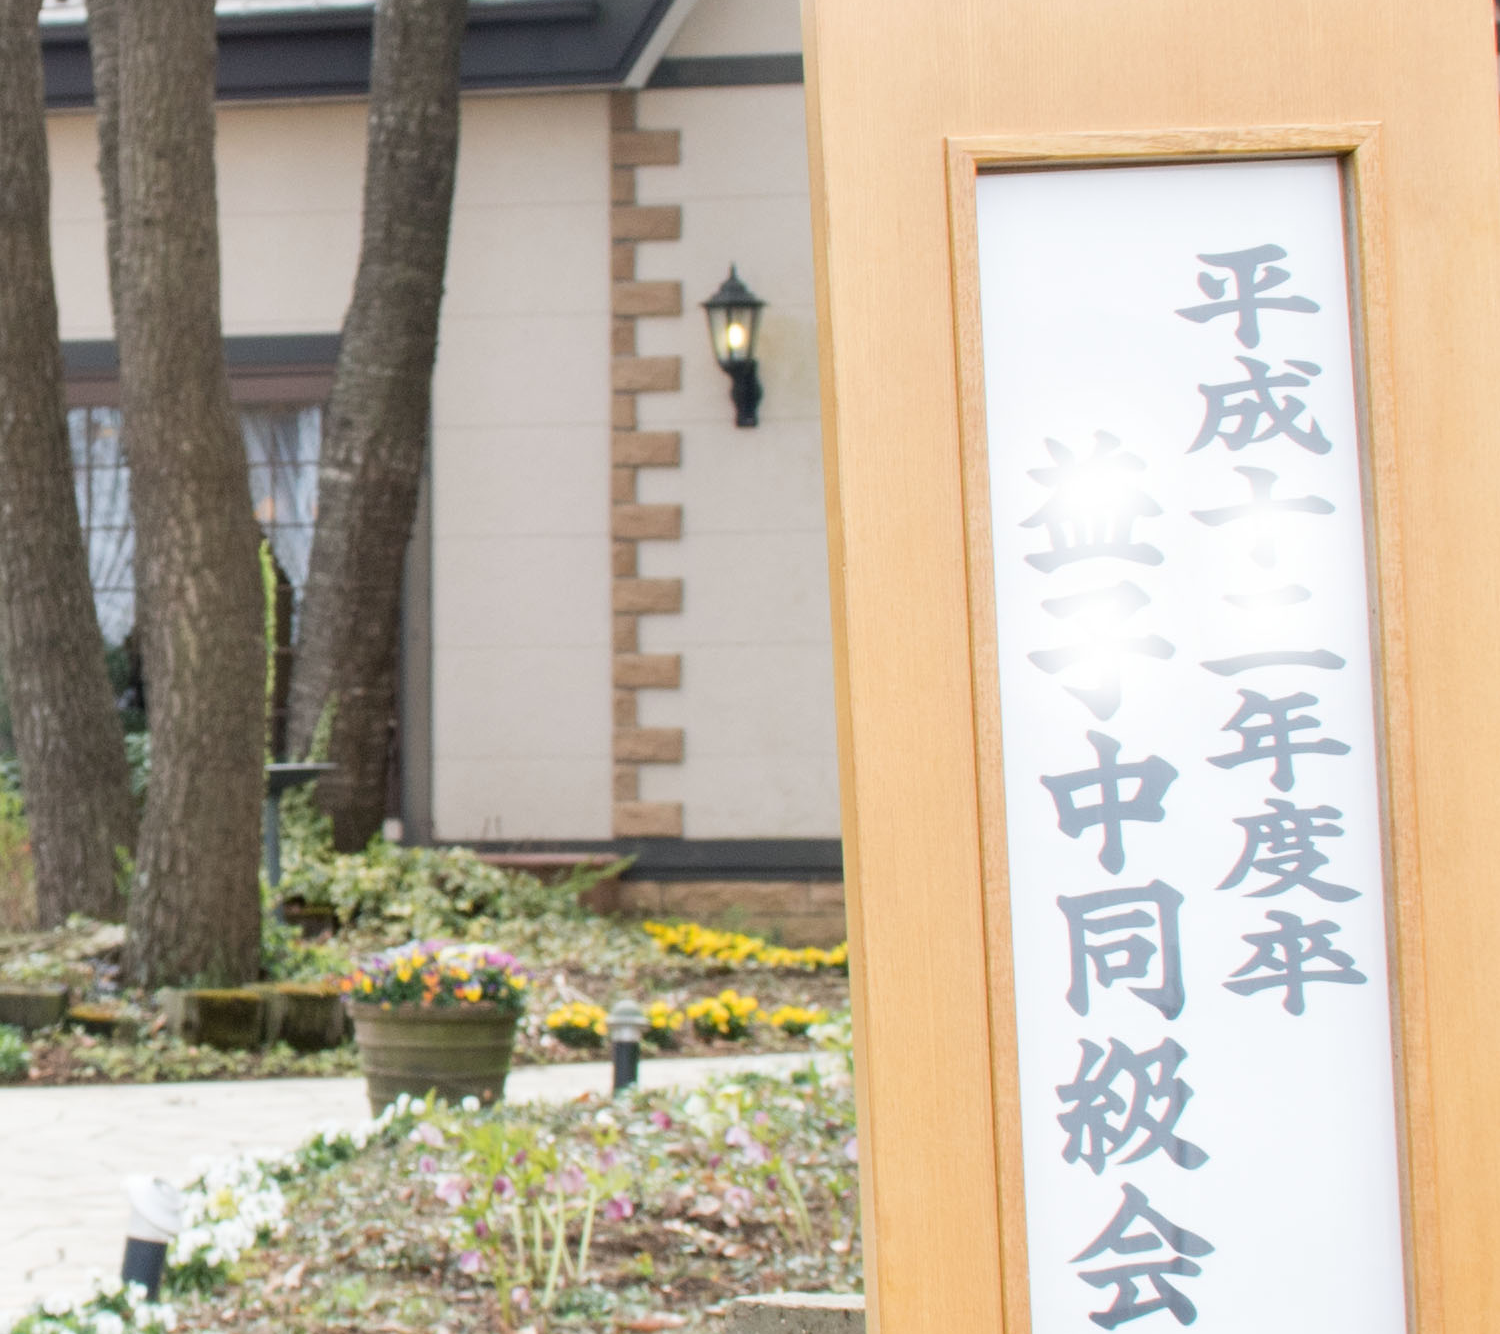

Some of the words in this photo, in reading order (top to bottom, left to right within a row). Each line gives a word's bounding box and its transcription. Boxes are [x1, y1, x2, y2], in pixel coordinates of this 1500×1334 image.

[1018, 429, 1215, 1332] 益子中同級会
[1174, 242, 1368, 1017] 平成十二年度卒
